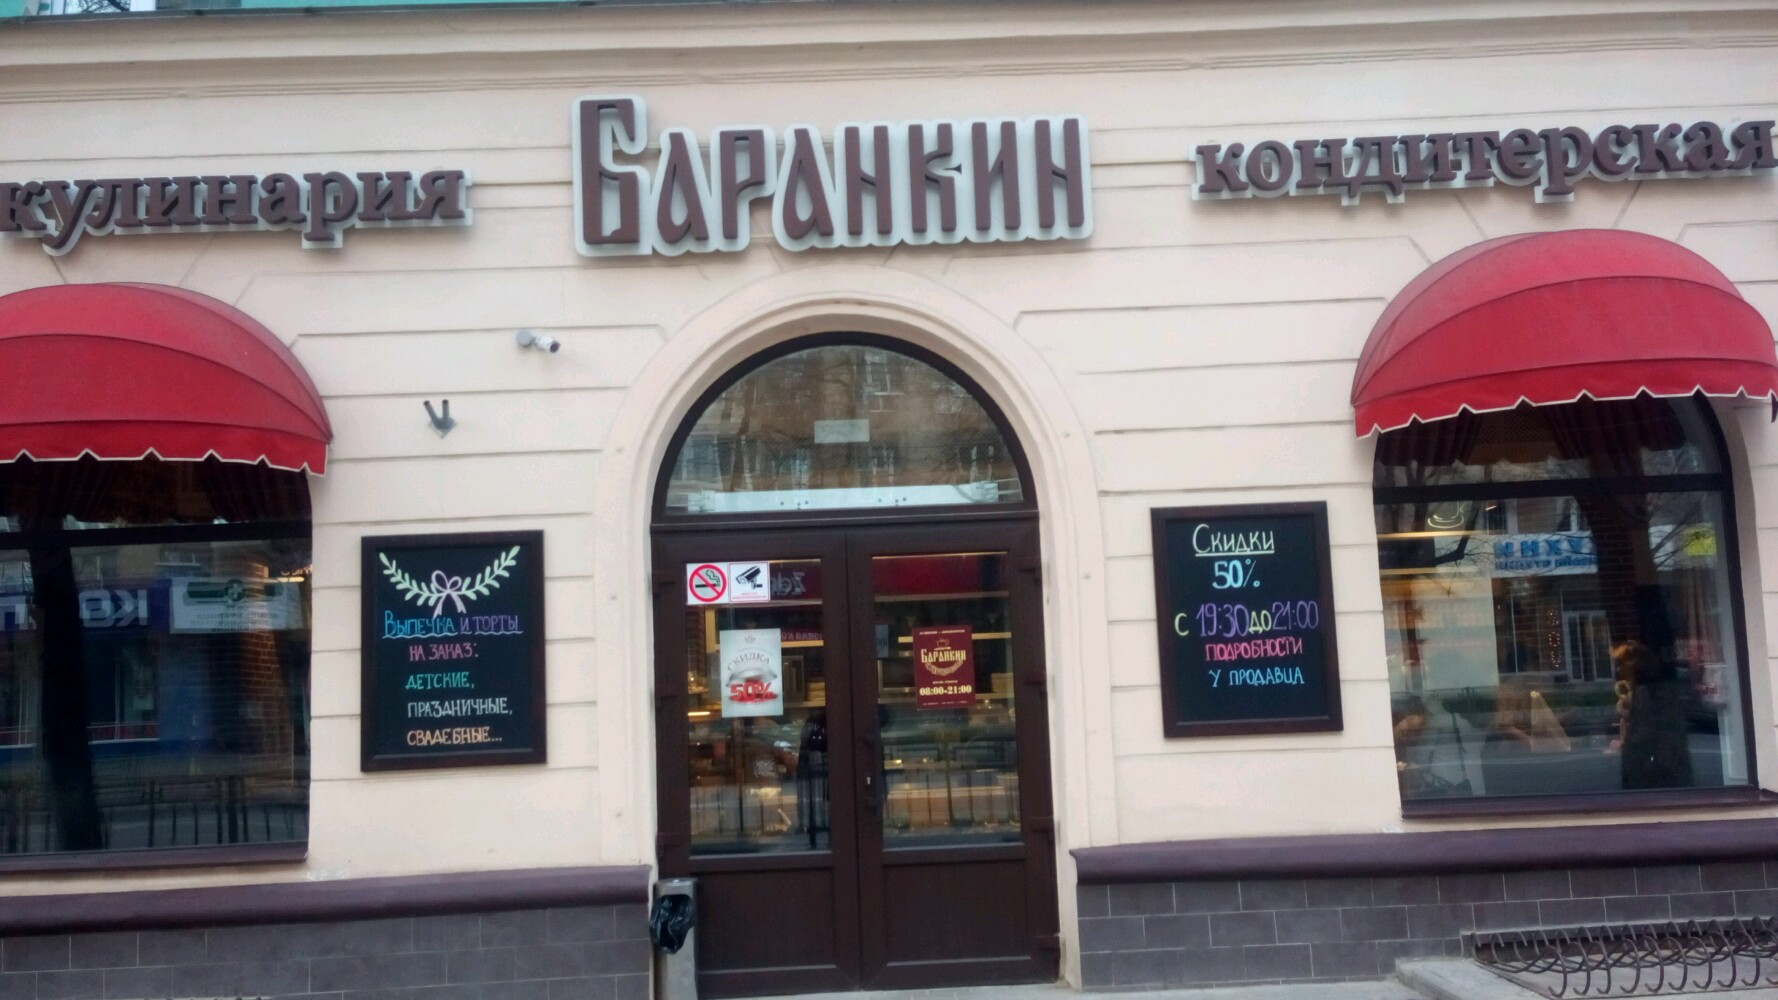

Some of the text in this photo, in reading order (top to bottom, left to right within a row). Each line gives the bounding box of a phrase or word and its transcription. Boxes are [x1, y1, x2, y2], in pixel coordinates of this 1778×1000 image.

[1195, 119, 1778, 197] кондитерская
[577, 97, 1087, 247] БАРАНКИН
[0, 168, 468, 250] кулинария
[1212, 559, 1261, 589] 50%
[1196, 602, 1249, 638] 19:30
[1271, 601, 1320, 630] 21:00
[409, 645, 426, 662] НА
[1204, 637, 1304, 662] ПОДРОБНОСТИ
[405, 672, 475, 689] ДЕТСКИЕ,
[1229, 666, 1305, 686] ПРОДАВЦА
[729, 681, 775, 702] 50%
[919, 684, 972, 696] 08:00-21:00
[407, 697, 513, 719] ПРАЗДНИЧНЫЕ,
